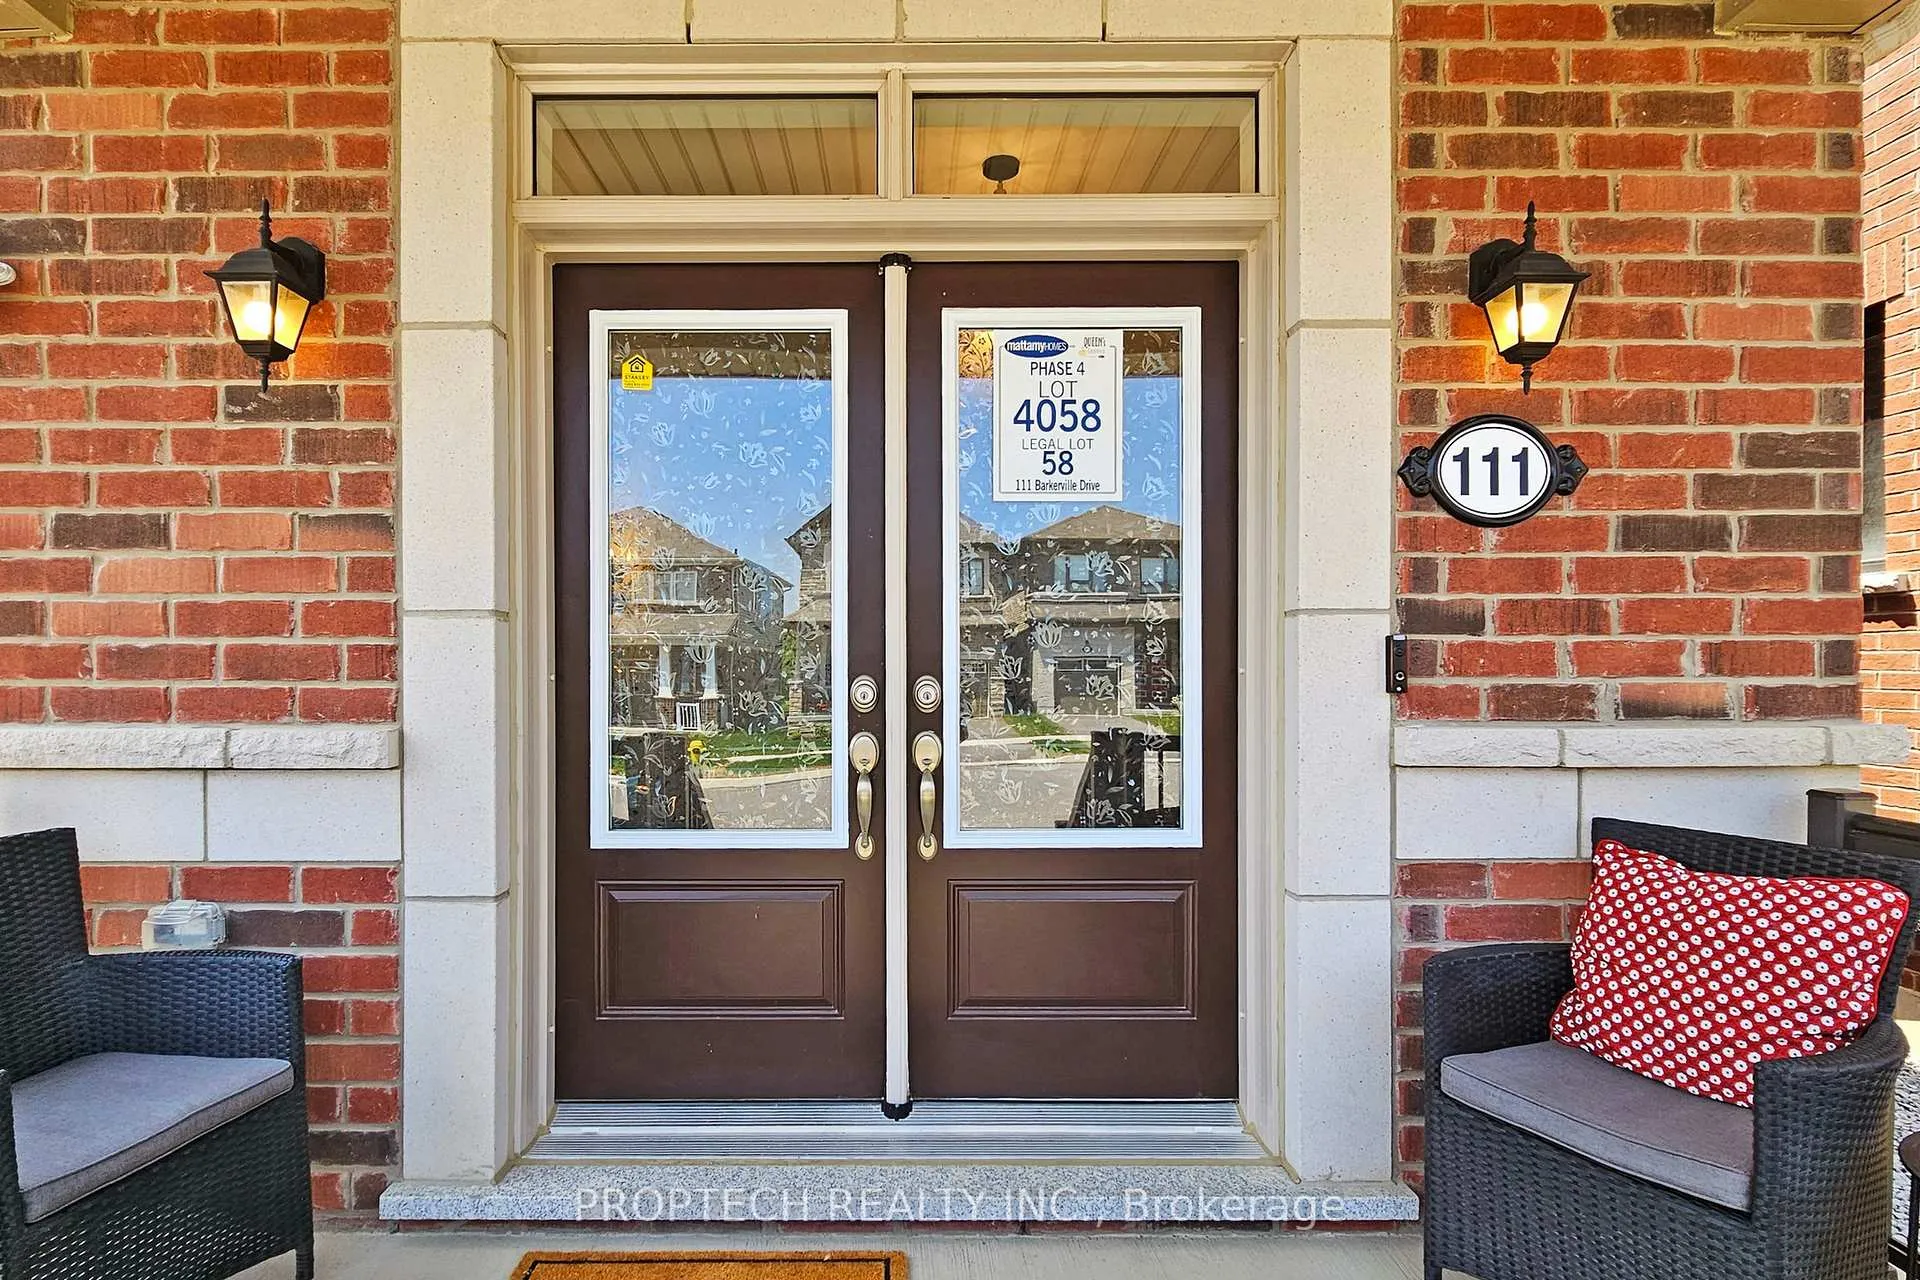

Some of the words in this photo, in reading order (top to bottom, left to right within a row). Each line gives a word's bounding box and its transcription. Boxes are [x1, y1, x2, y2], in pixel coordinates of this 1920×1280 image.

[1030, 361, 1073, 375] PHASE
[1076, 361, 1085, 375] 4
[1039, 380, 1078, 398] LOT
[1013, 398, 1102, 432] 4058
[1021, 438, 1064, 450] LEGAL
[1069, 438, 1095, 450] LOT
[1041, 450, 1074, 475] 58
[1452, 447, 1529, 496] 111
[1015, 479, 1031, 491] 111
[1035, 479, 1077, 491] Barkerville
[1080, 479, 1101, 491] Drive
